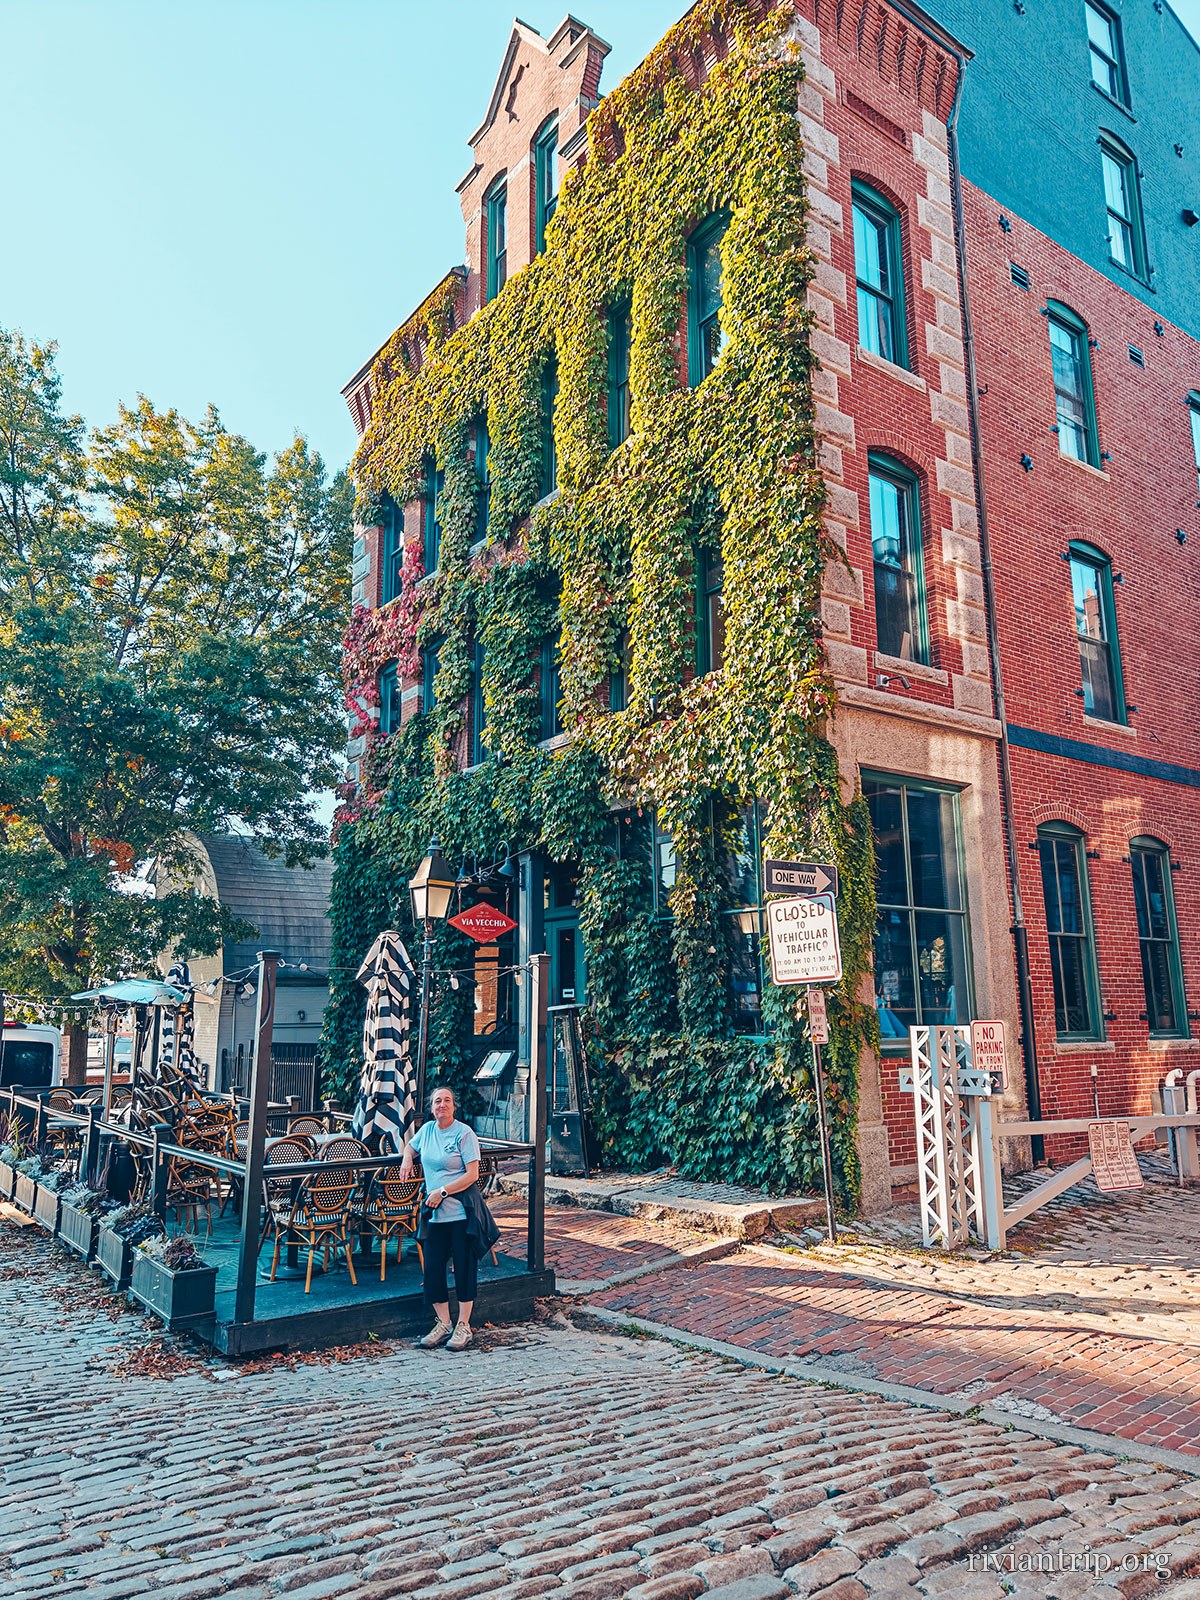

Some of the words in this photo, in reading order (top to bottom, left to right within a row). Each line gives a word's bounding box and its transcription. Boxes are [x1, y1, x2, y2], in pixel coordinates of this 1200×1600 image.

[775, 872, 795, 883] ONE
[798, 873, 817, 885] WAY
[775, 902, 826, 923] CLOSED
[796, 920, 806, 930] TO
[777, 928, 829, 944] VEHICULAR
[786, 941, 822, 954] TRAFFIC
[982, 1026, 994, 1040] NO
[976, 1041, 1003, 1054] PARKING
[977, 1056, 984, 1065] IN
[986, 1055, 1004, 1065] FRONT
